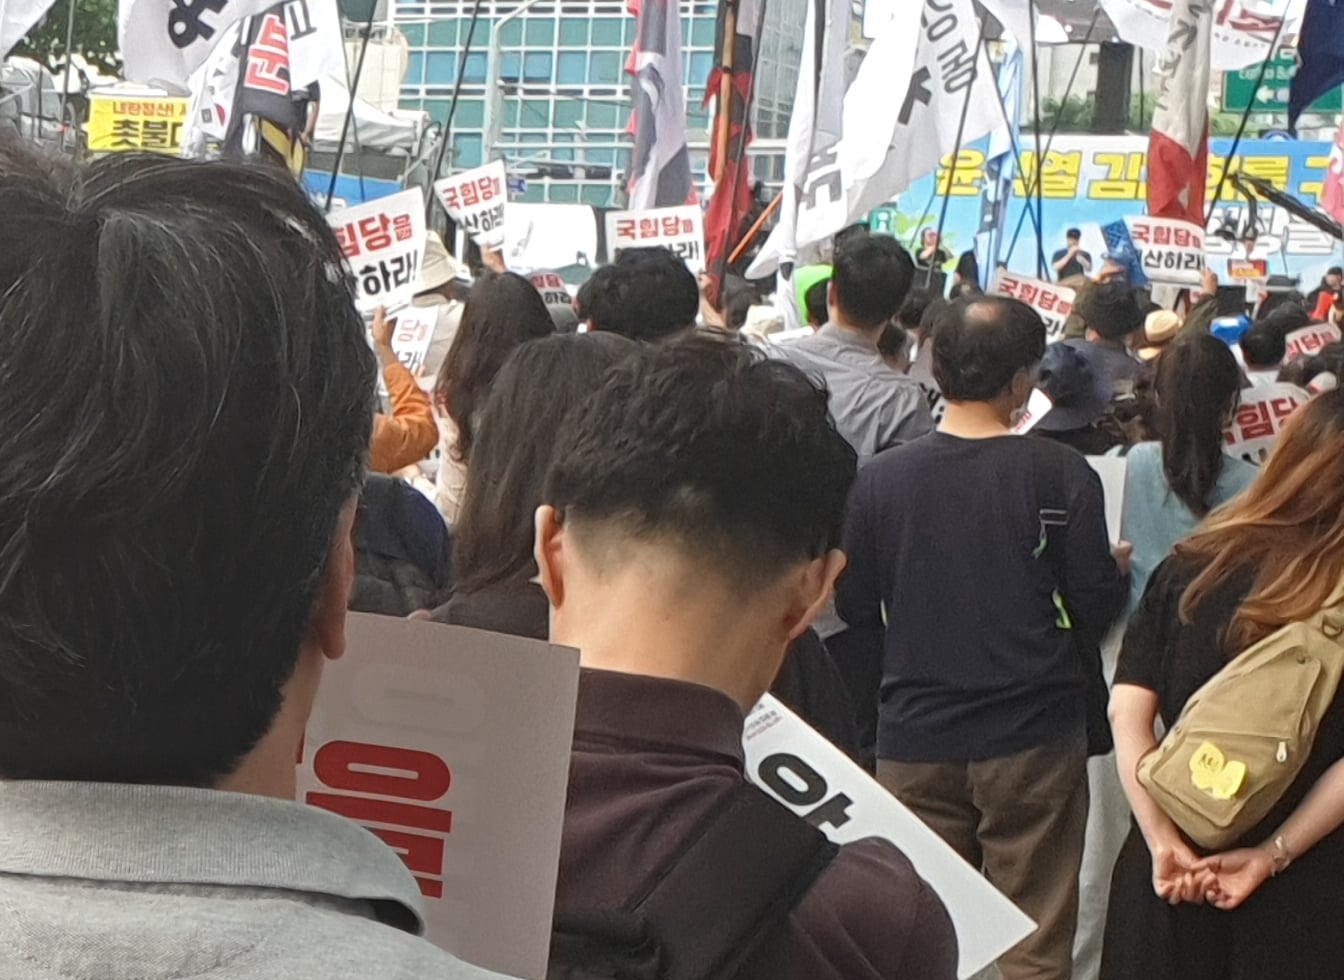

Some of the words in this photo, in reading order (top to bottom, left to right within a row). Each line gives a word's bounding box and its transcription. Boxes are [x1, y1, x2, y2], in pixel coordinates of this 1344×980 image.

[935, 148, 1082, 198] 윤열
[336, 212, 412, 258] 힘당을
[359, 249, 418, 296] 하라!
